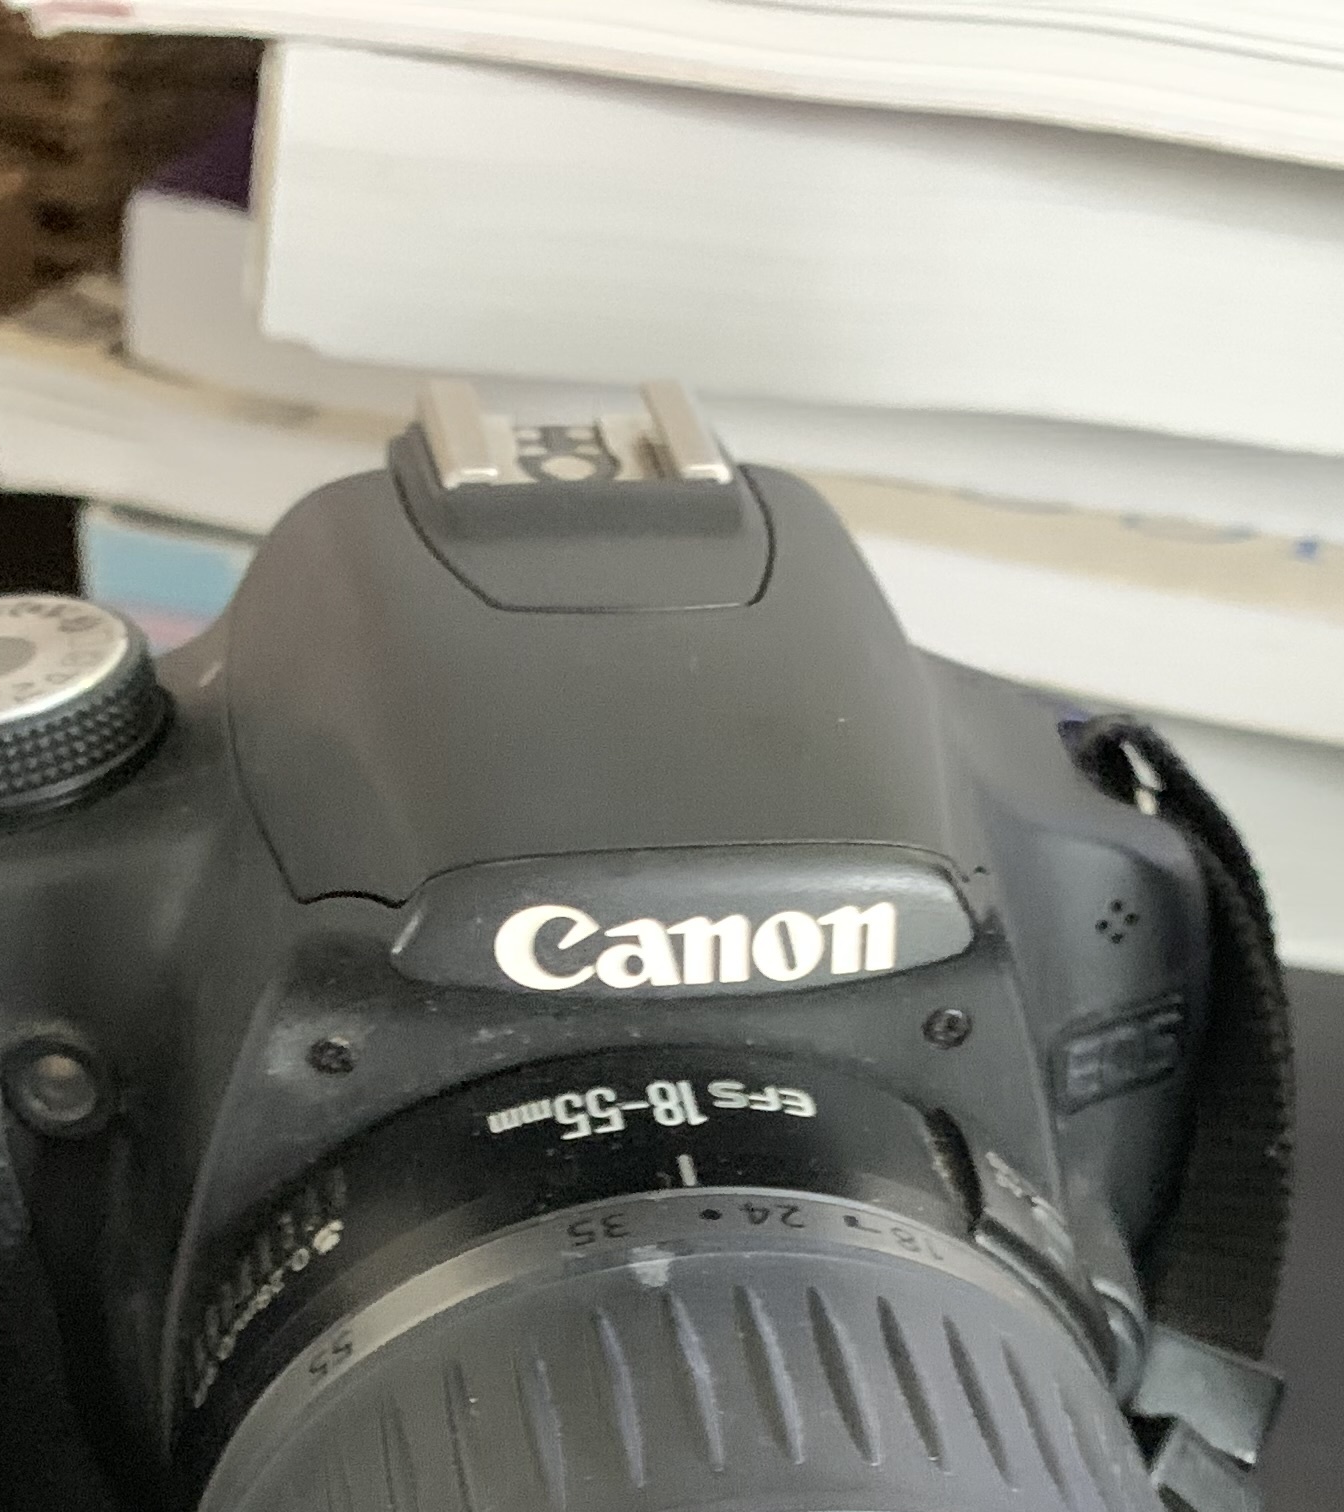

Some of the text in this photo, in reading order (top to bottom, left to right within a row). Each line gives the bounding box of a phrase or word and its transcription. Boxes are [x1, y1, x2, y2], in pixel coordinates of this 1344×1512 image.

[493, 901, 898, 992] Canon
[567, 1212, 630, 1248] 35
[739, 1201, 806, 1229] 24
